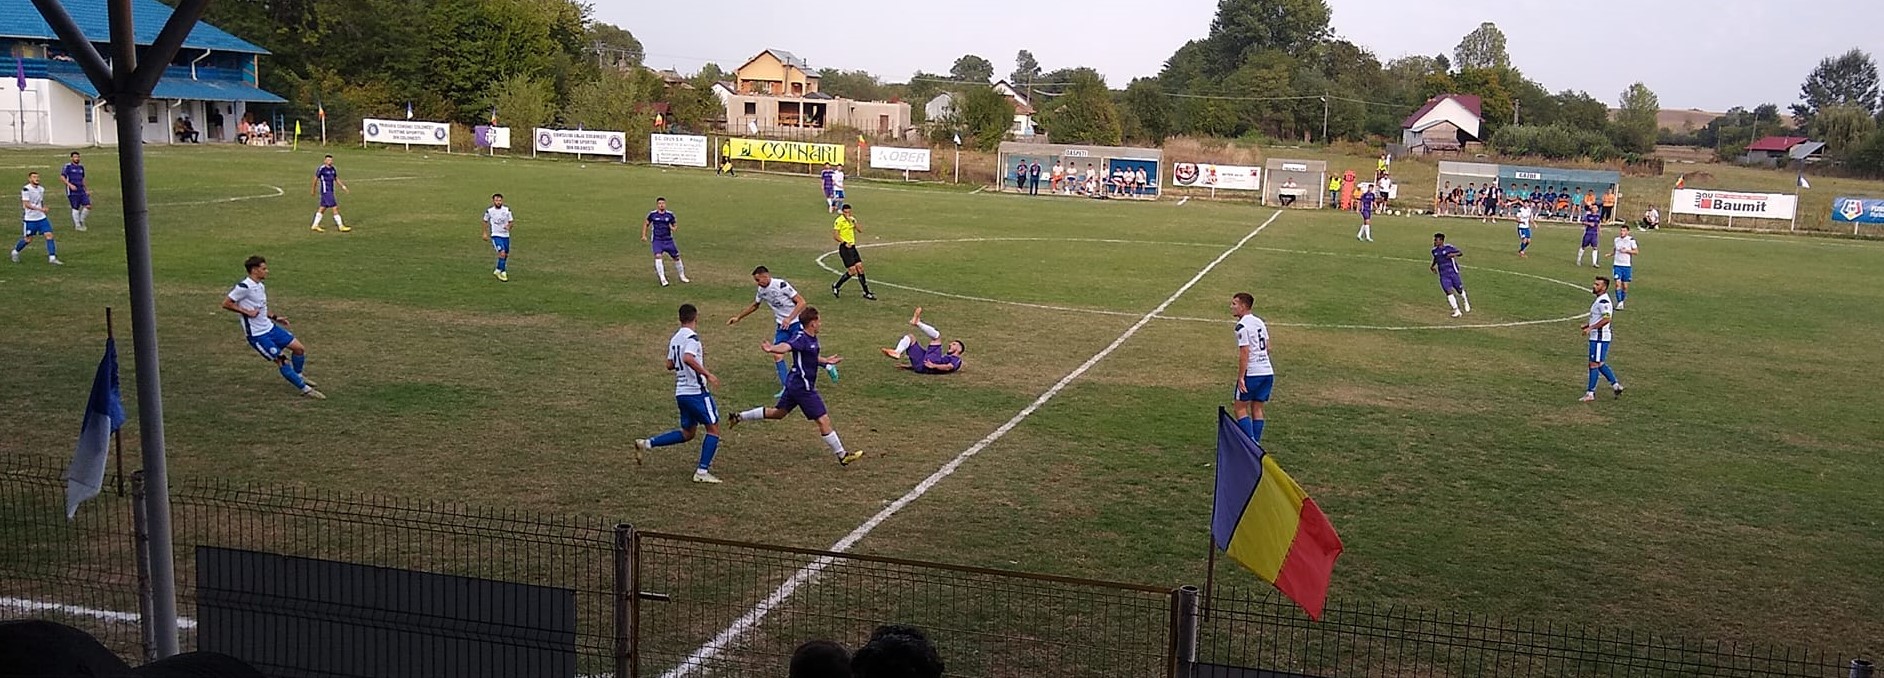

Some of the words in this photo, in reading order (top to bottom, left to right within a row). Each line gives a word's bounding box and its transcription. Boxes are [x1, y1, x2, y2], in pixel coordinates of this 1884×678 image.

[761, 142, 837, 162] COTNARI
[878, 150, 926, 163] KOBER
[1713, 199, 1767, 212] Baumit
[1257, 328, 1266, 351] 6
